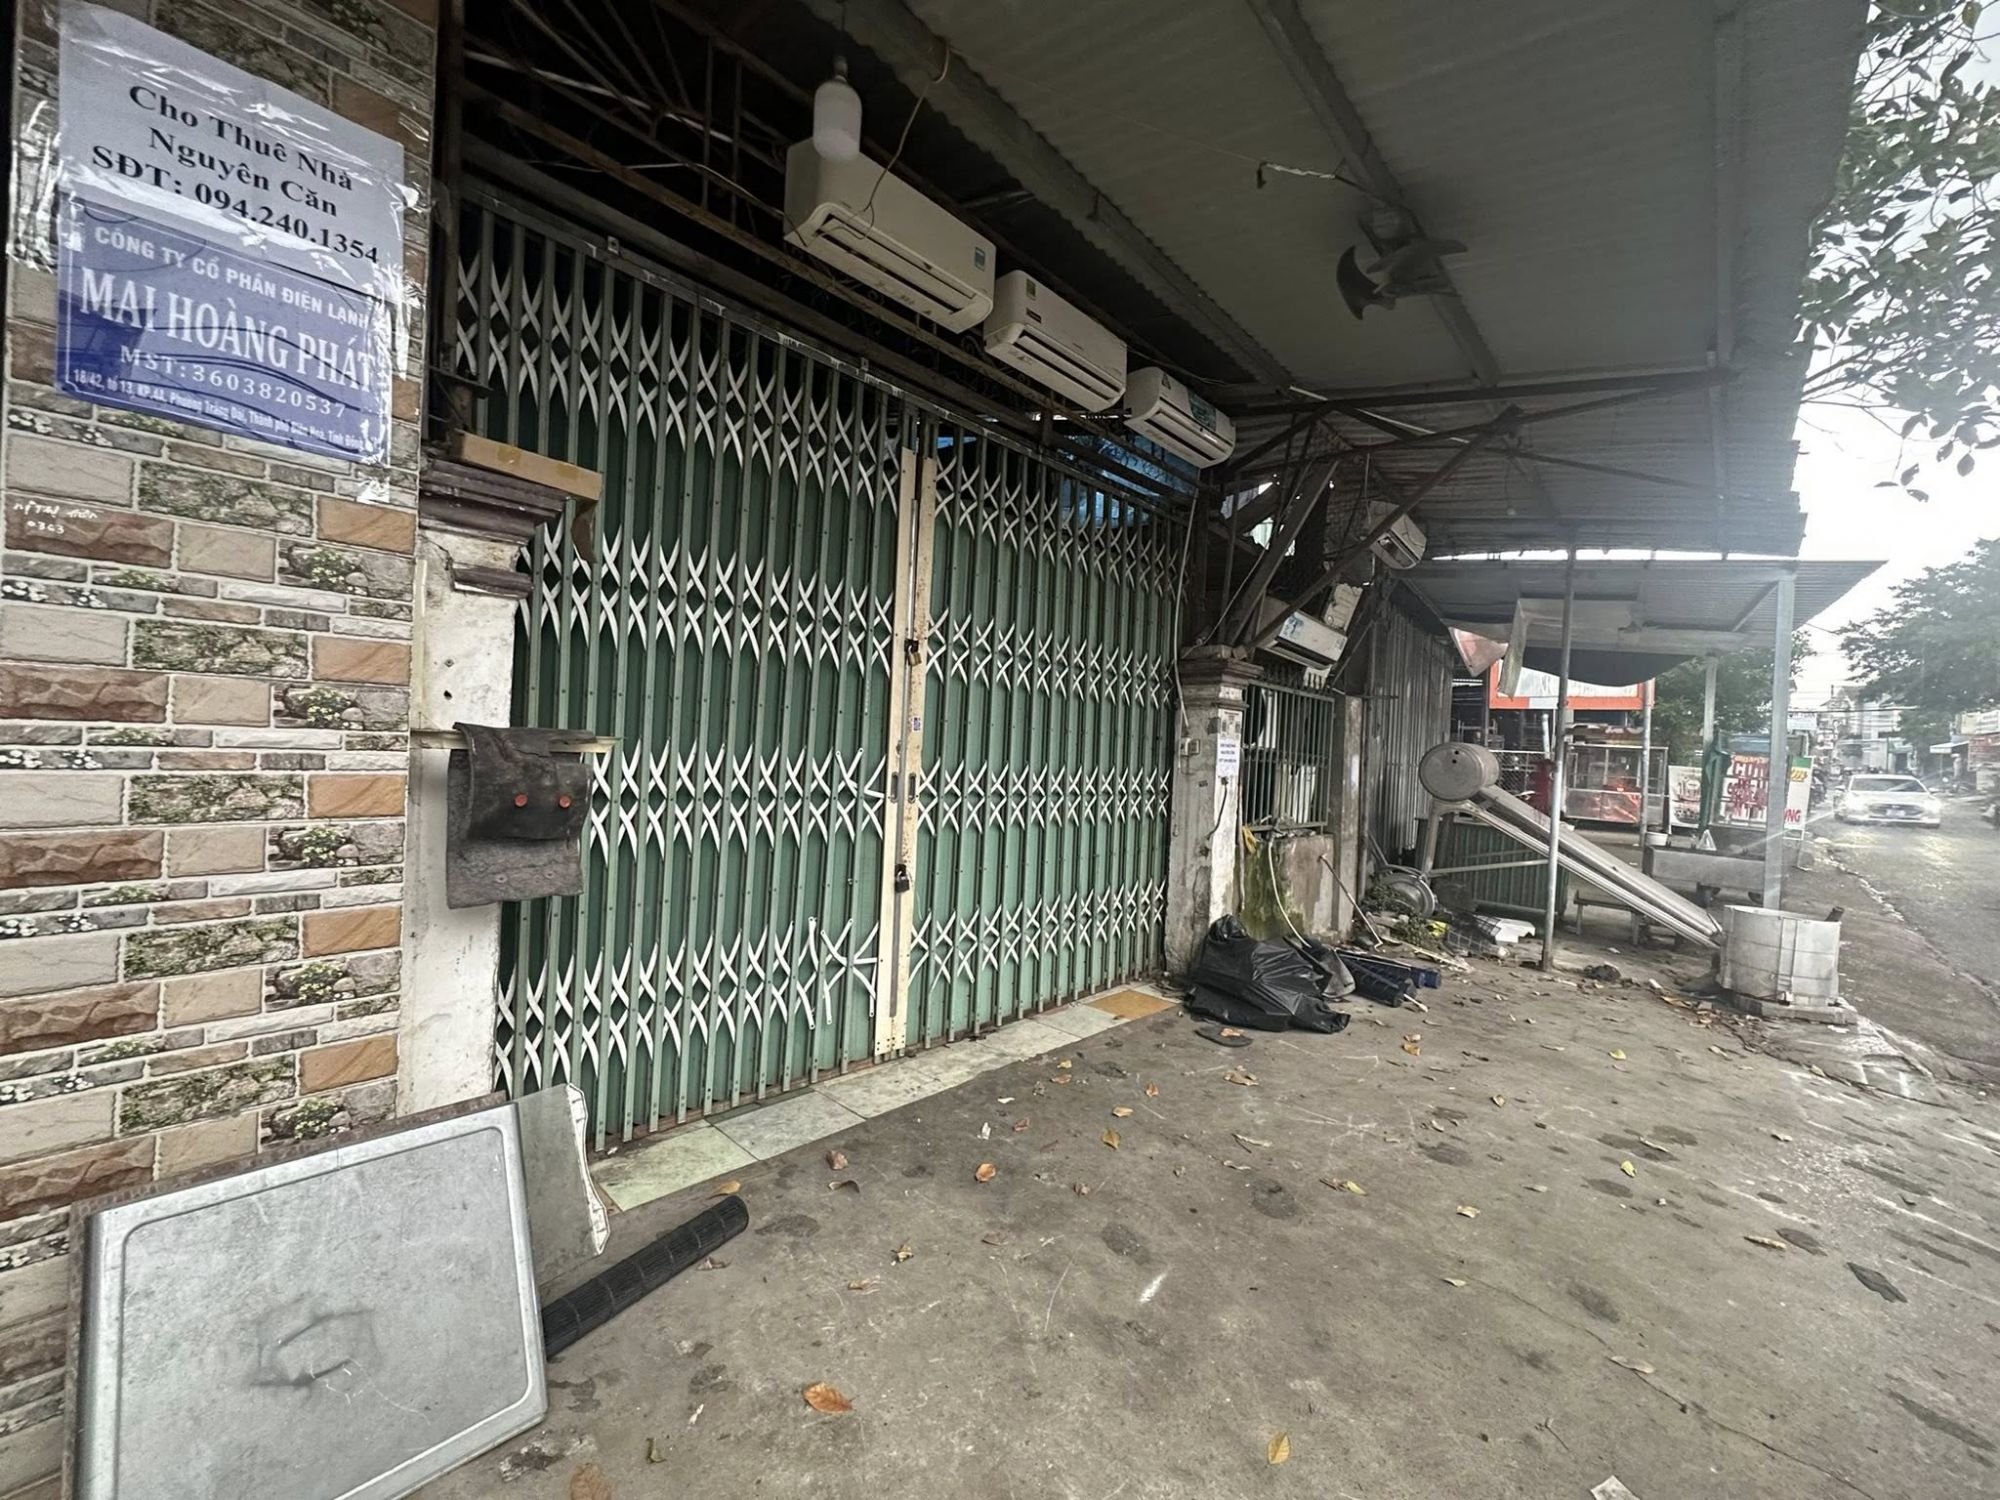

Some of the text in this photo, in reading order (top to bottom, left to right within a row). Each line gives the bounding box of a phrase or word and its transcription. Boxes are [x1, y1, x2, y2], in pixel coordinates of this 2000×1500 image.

[129, 85, 354, 191] Cho Thuê Nhà
[148, 126, 338, 217] Nguyên Căn
[93, 145, 380, 264] SĐT: 094.240.1354
[80, 266, 376, 393] MAI HOÀNG PHÁT
[95, 226, 369, 329] CÔNG TY CỔ PHẦN ĐIỆN LẠNH
